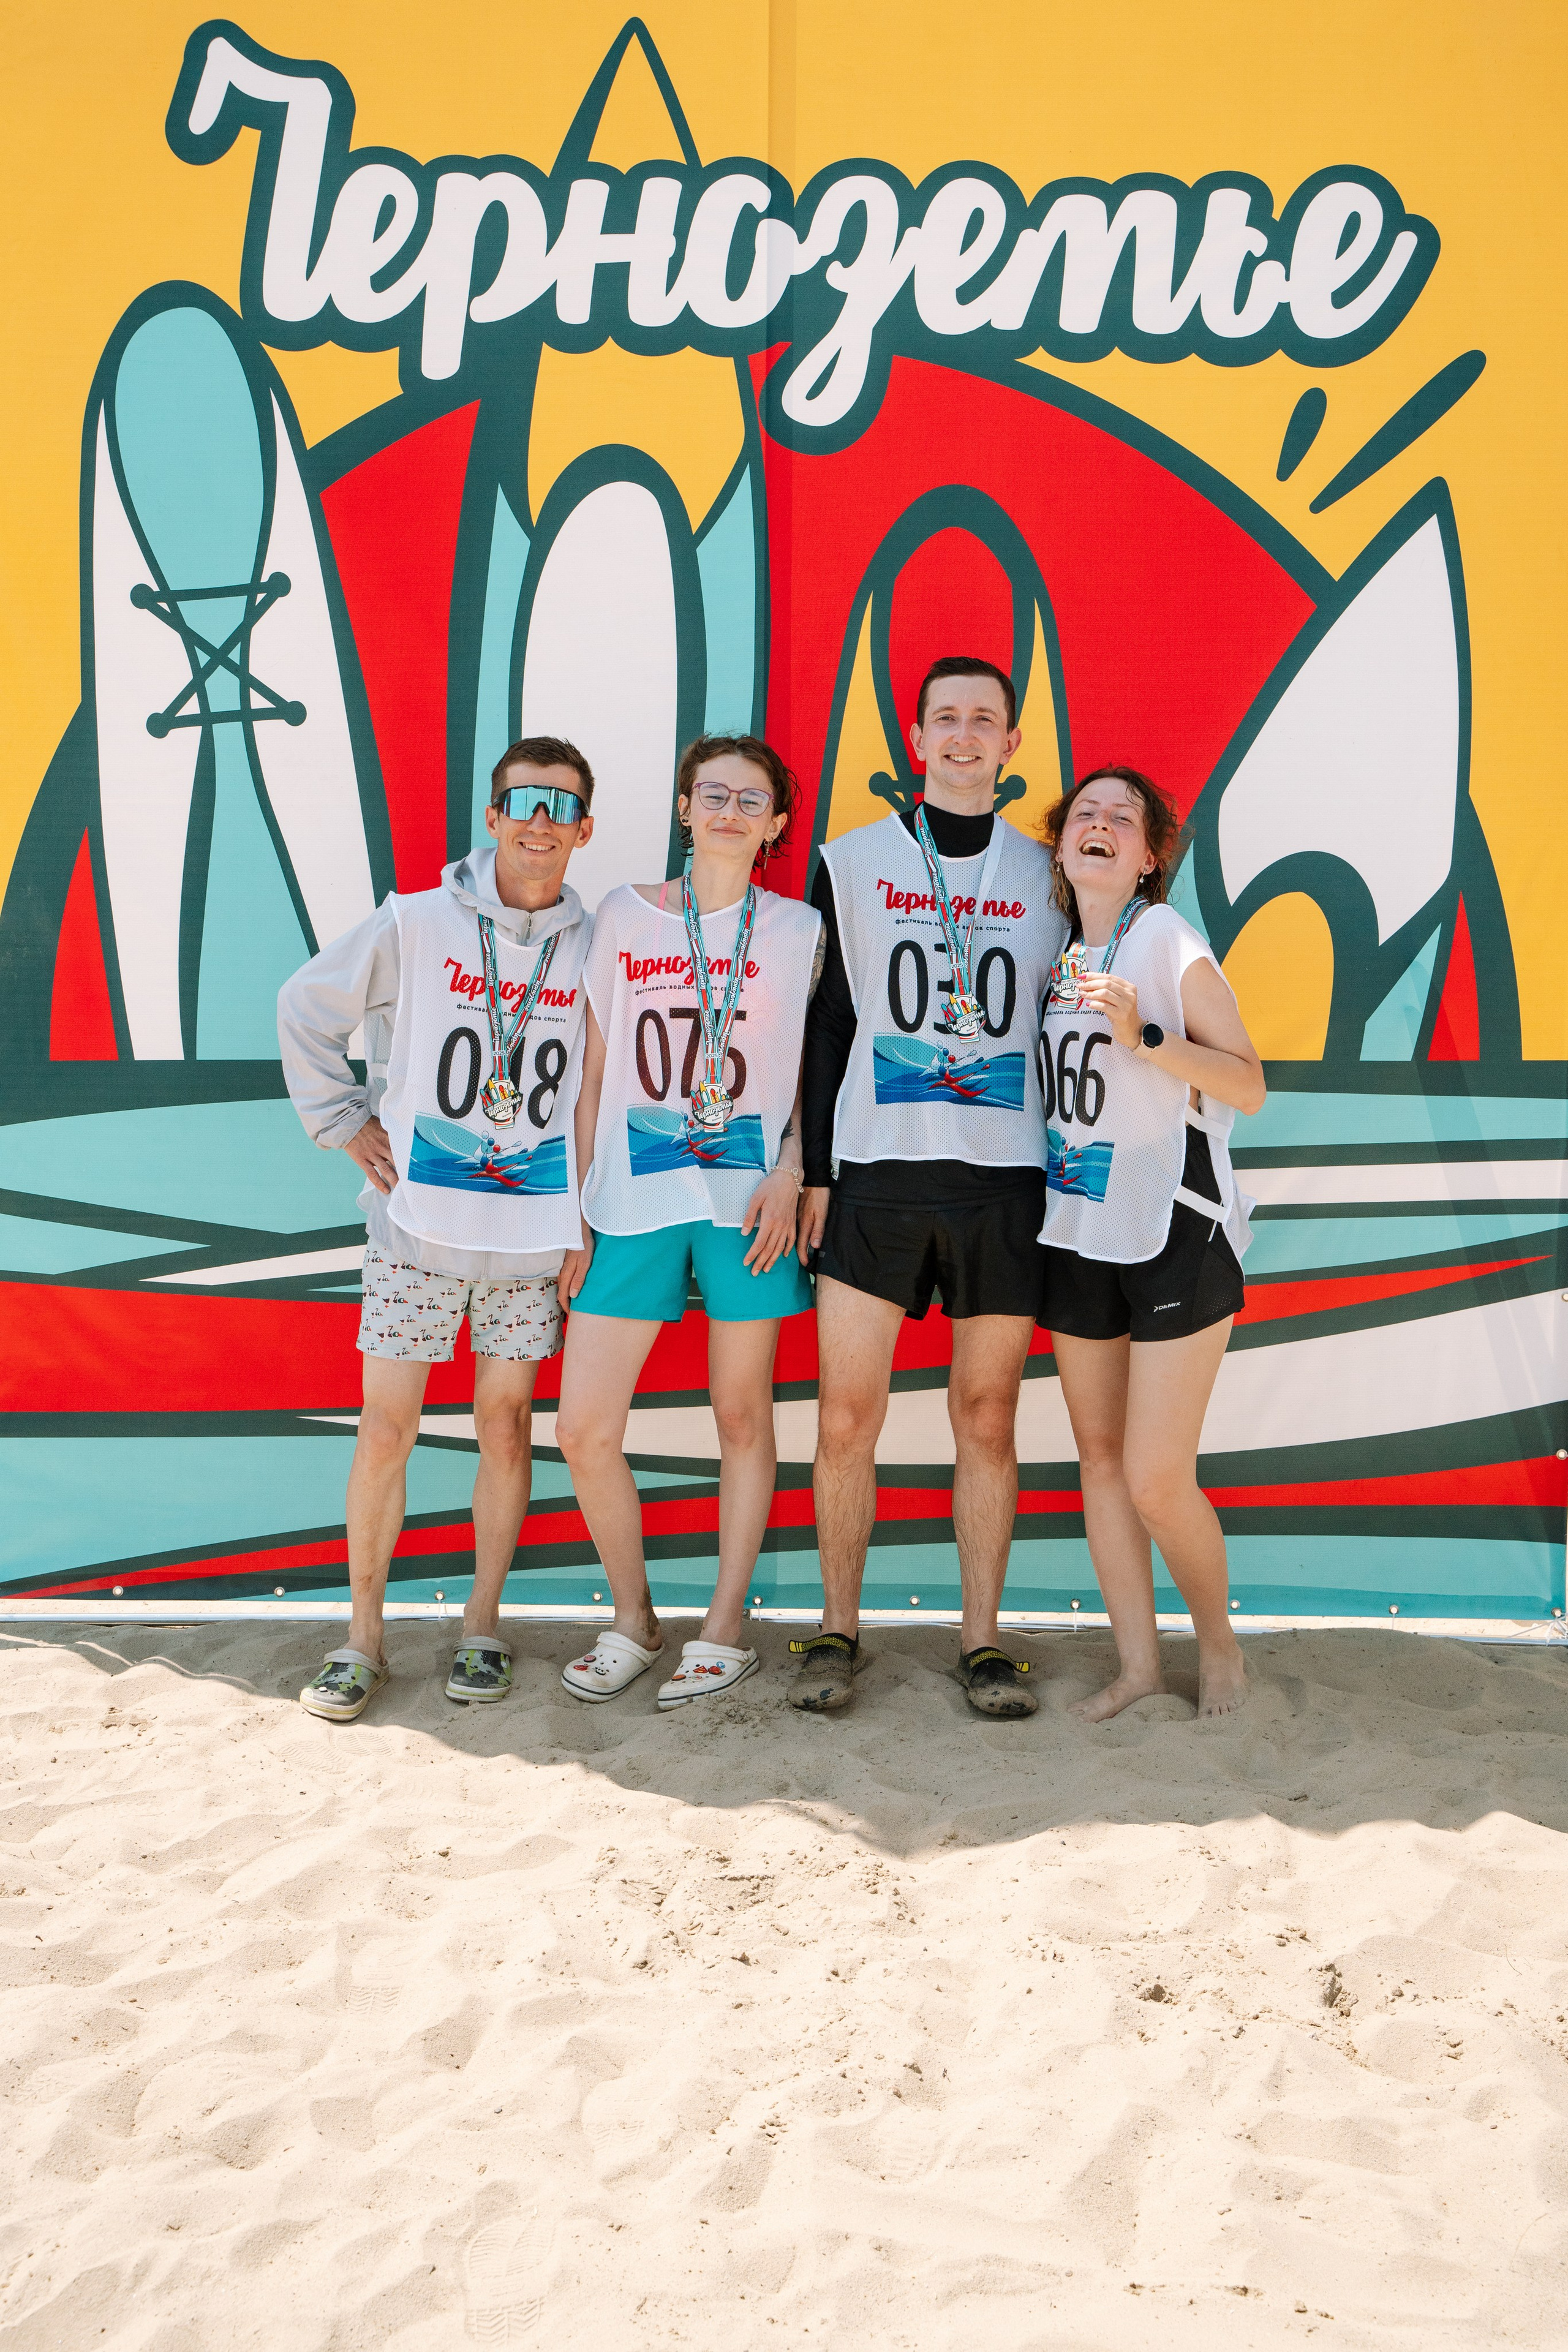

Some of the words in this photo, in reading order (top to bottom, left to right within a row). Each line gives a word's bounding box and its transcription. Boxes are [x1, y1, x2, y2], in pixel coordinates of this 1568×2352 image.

[187, 36, 1420, 427] Черноземье
[877, 878, 1026, 924] Чернземье
[619, 951, 760, 985] Чернозме
[963, 940, 973, 973] Чернозем
[443, 957, 577, 1013] Черозмь
[635, 985, 666, 996] фестиваль
[456, 1003, 488, 1012] фестива
[948, 1010, 986, 1031] Черноземье
[718, 1031, 731, 1065] Чернозем
[485, 1096, 521, 1117] Черноземье
[695, 1101, 733, 1120] Черноземье
